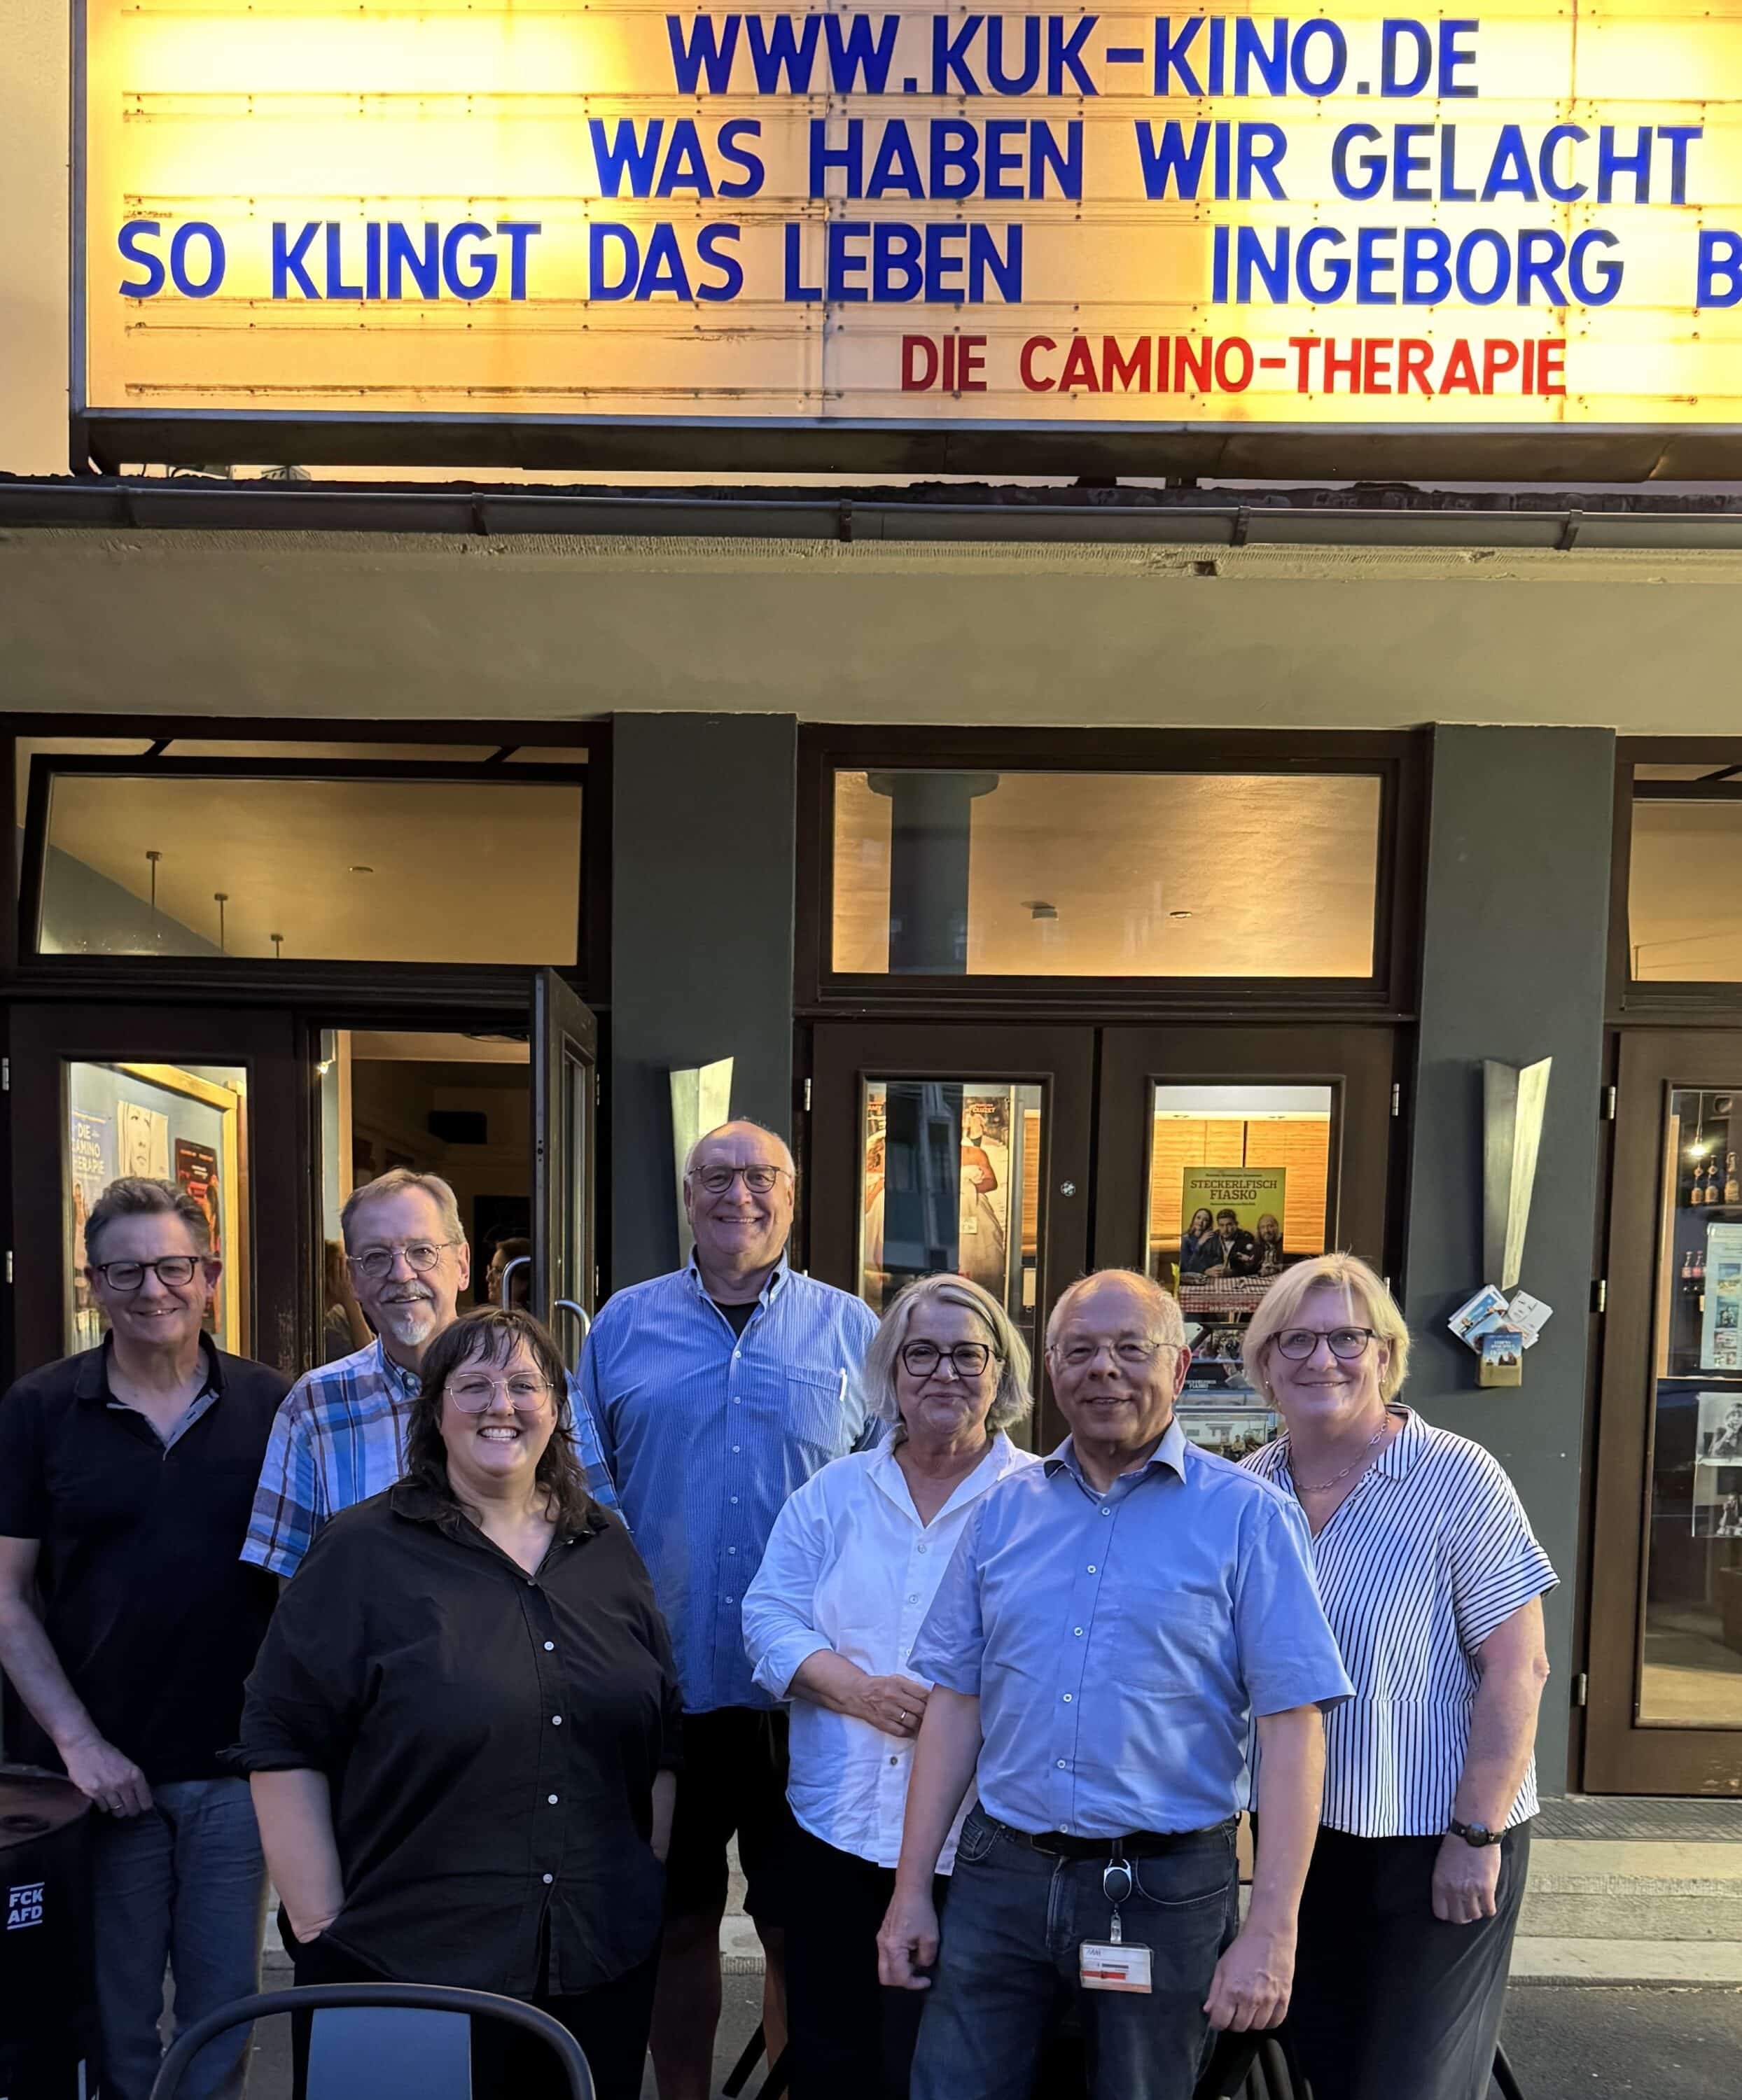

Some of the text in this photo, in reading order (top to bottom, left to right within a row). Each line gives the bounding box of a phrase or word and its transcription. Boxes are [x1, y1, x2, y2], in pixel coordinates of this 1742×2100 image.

[667, 13, 1479, 99] WWW.KUK-KINO.DE
[588, 118, 1703, 204] WAS HABEN WIR GELACHT
[118, 220, 1022, 304] SO KLINGT DAS LEBEN
[1212, 224, 1742, 309] INGEBORG B
[901, 335, 1566, 396] DIE CAMINO-THERAPIE
[1190, 1180, 1277, 1189] STECKERLFISCH
[1210, 1189, 1257, 1200] FIASKO
[7, 1905, 43, 1924] AFD
[9, 1888, 43, 1907] FCK
